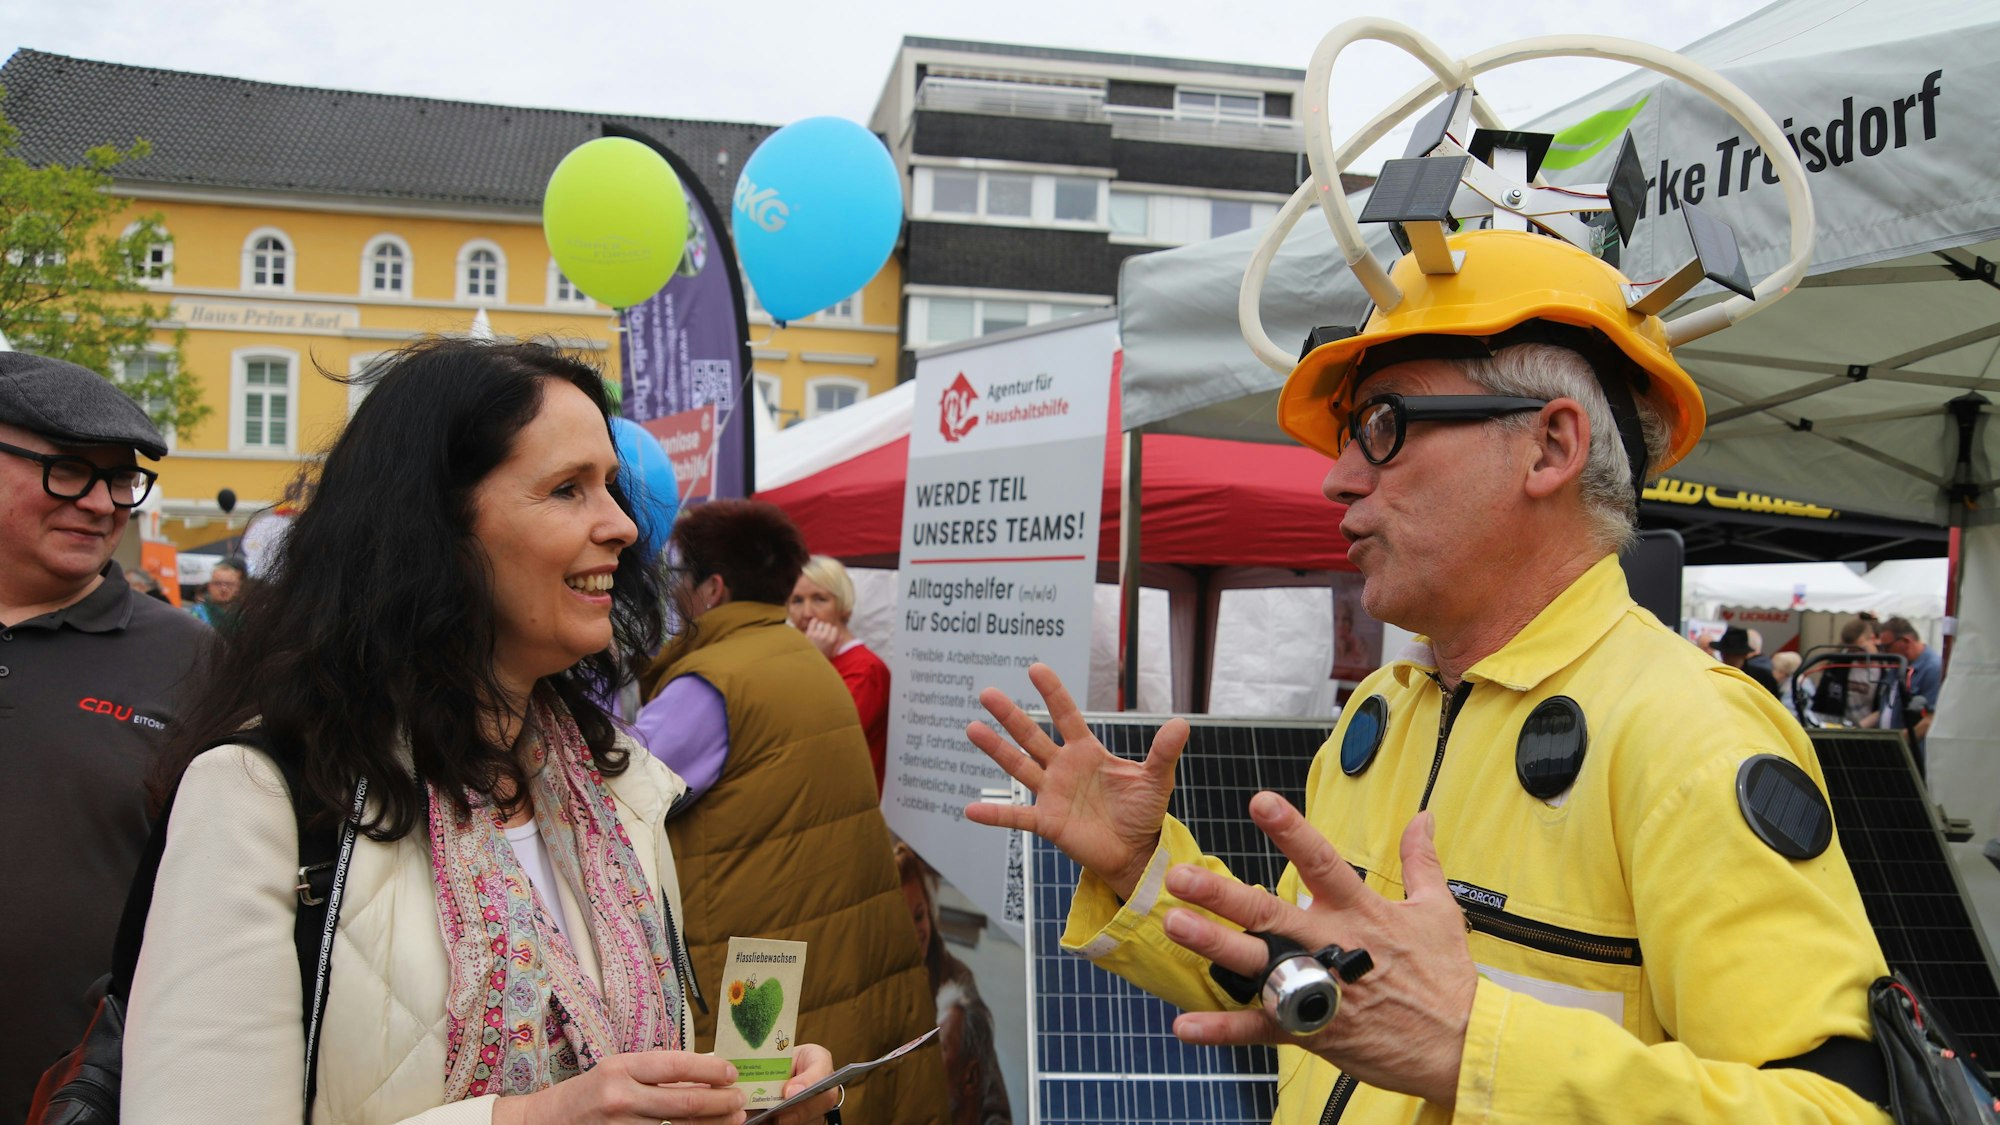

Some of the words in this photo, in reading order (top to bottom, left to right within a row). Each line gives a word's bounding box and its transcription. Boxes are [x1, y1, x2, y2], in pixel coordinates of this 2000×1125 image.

[191, 306, 237, 323] Haus
[243, 309, 295, 326] Prinz
[302, 312, 341, 329] Karl
[987, 381, 1032, 402] Agentur
[1035, 372, 1053, 391] für
[986, 398, 1069, 426] Haushaltshilfe
[916, 480, 982, 508] WERDE
[989, 476, 1027, 503] TEIL
[913, 518, 998, 546] UNSERES
[1006, 511, 1085, 543] TEAMS!
[907, 577, 1014, 606] Alltagshelfer
[1019, 584, 1057, 603] (m/w/d)
[905, 609, 926, 632] für
[930, 611, 981, 634] Social
[986, 612, 1065, 637] Business
[910, 648, 944, 662] Flexible
[946, 650, 1011, 667] Arbeitszeiten
[910, 669, 974, 690] Vereinbarung
[79, 697, 133, 721] CDU
[908, 690, 966, 708] Unbefristete
[904, 752, 957, 772] Betriebliche
[902, 774, 956, 794] Betriebliche
[1468, 889, 1503, 909] ORCON
[735, 951, 797, 964] #lassliebewachsen
